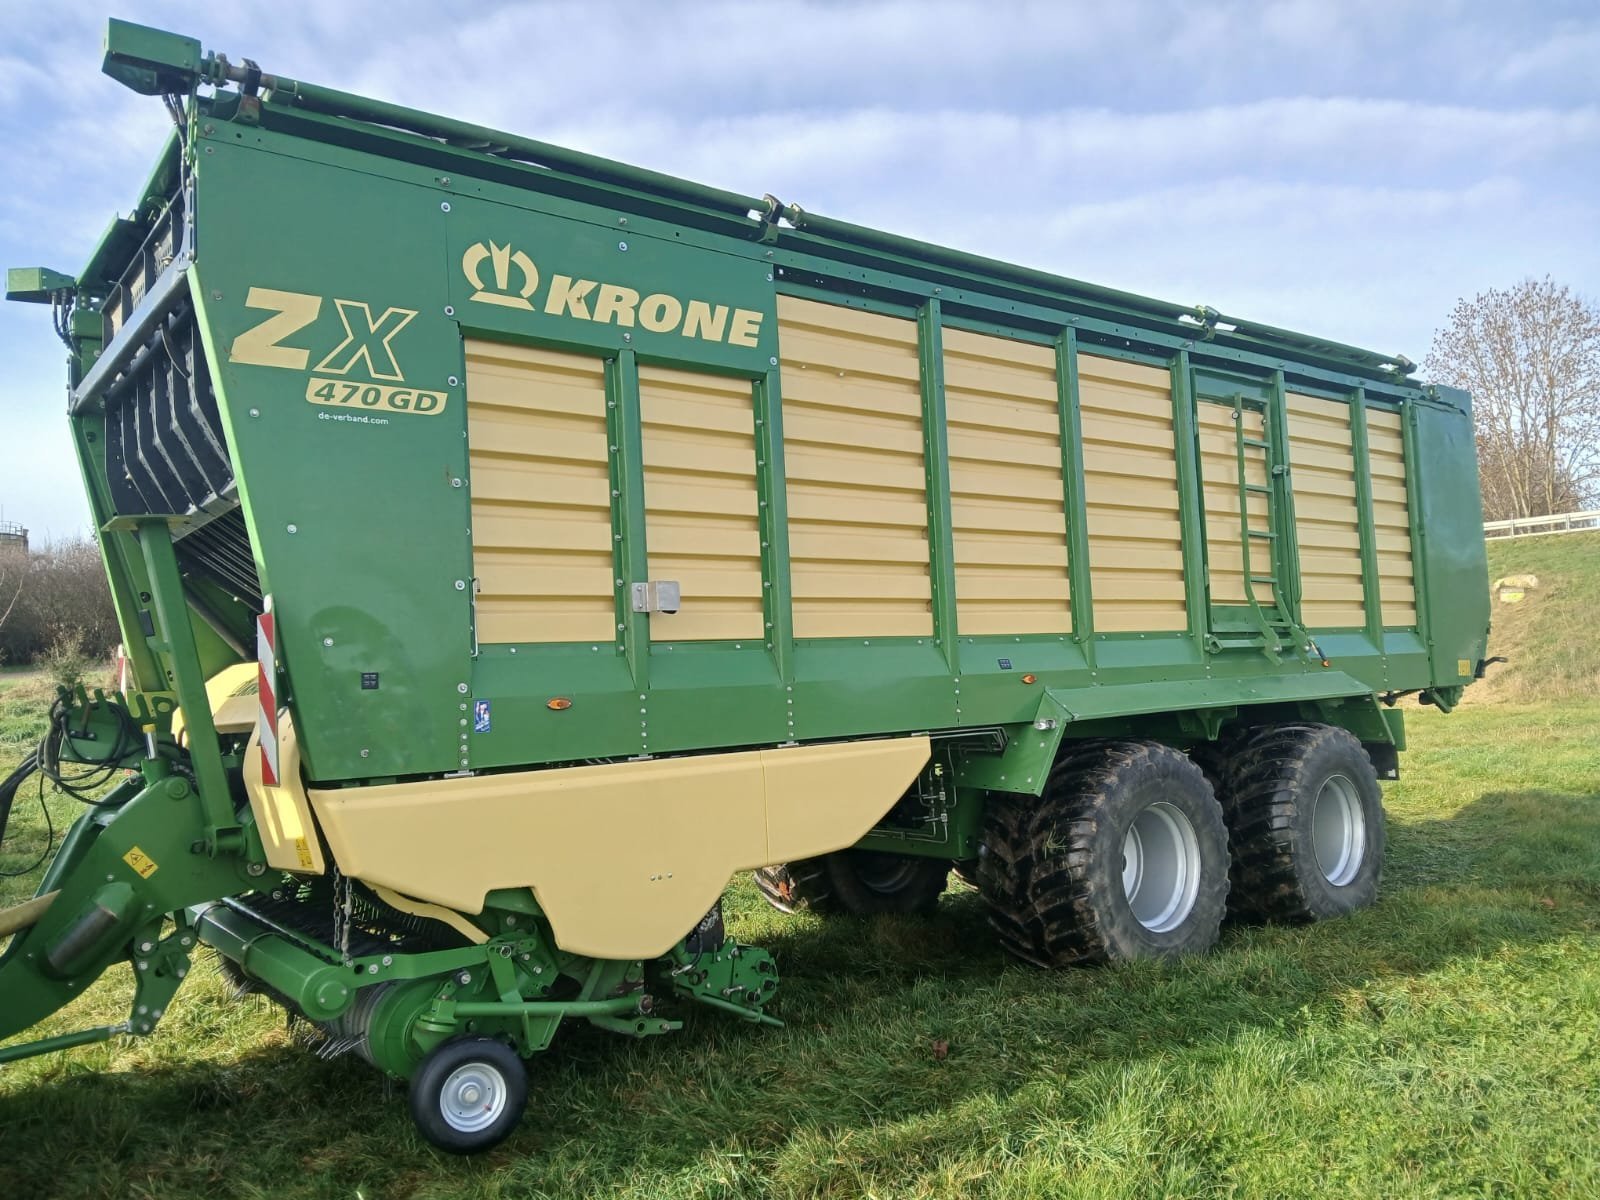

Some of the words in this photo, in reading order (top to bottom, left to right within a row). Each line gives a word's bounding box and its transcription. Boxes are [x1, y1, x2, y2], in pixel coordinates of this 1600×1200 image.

[229, 287, 419, 381] ZX
[544, 274, 764, 348] KRONE
[313, 382, 382, 406] 470
[387, 390, 438, 412] GD
[318, 411, 389, 425] de-verband.com
